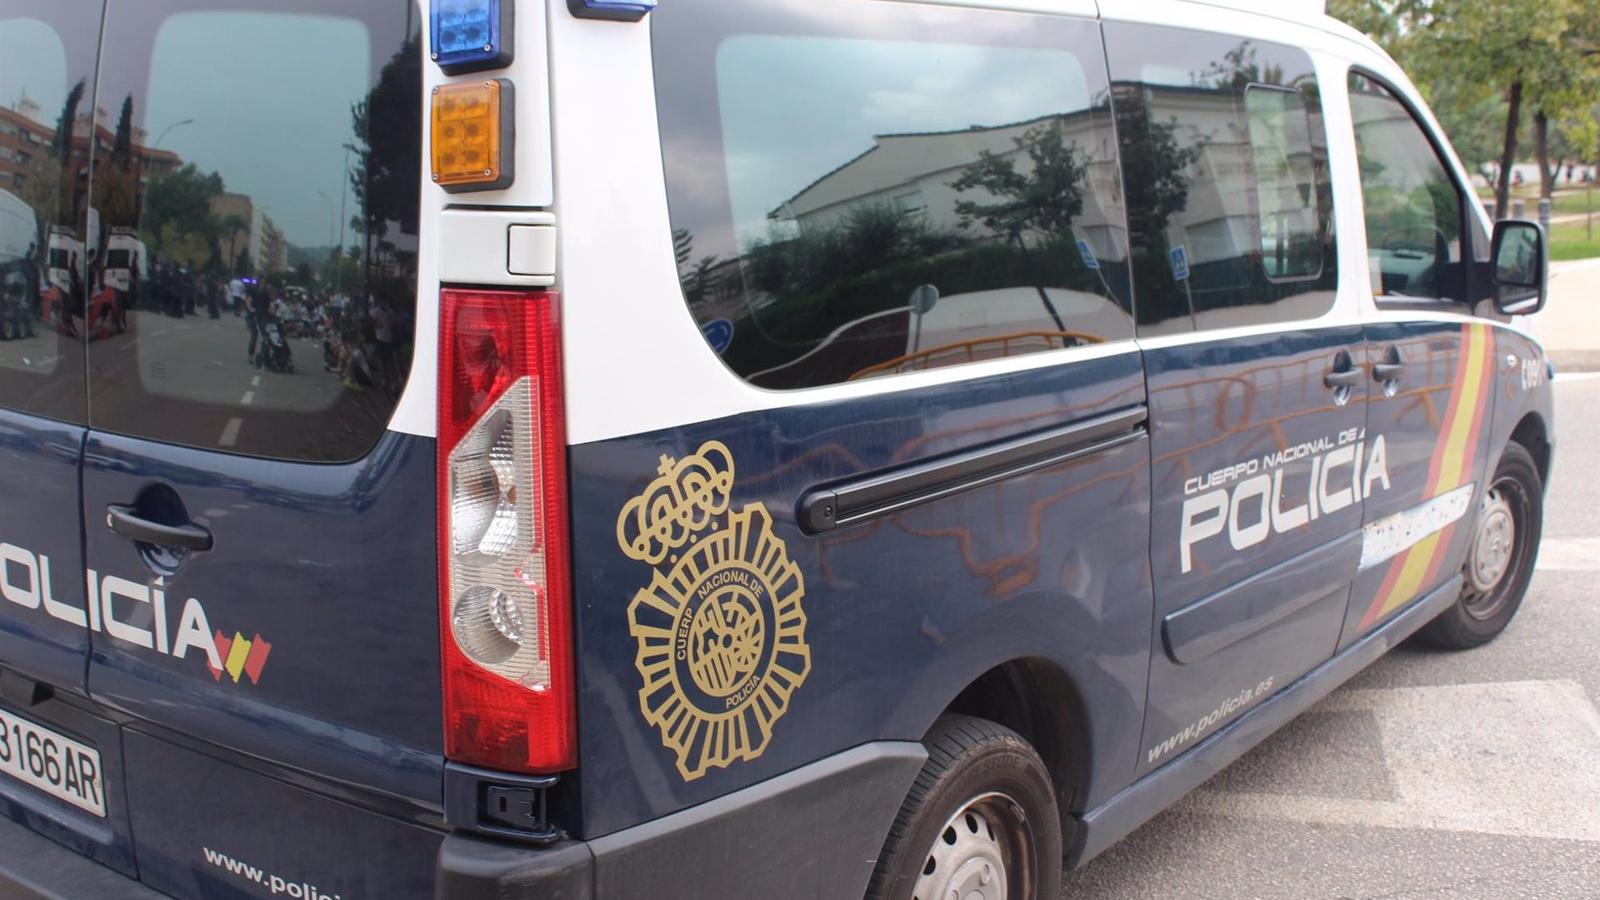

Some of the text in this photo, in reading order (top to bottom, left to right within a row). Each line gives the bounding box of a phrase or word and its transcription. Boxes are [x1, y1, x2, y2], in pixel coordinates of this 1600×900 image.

[1184, 427, 1358, 495] CUERPO NACIONAL DE
[697, 570, 749, 600] NACIONAL
[750, 579, 764, 599] DE
[1148, 675, 1274, 763] www.policia.es
